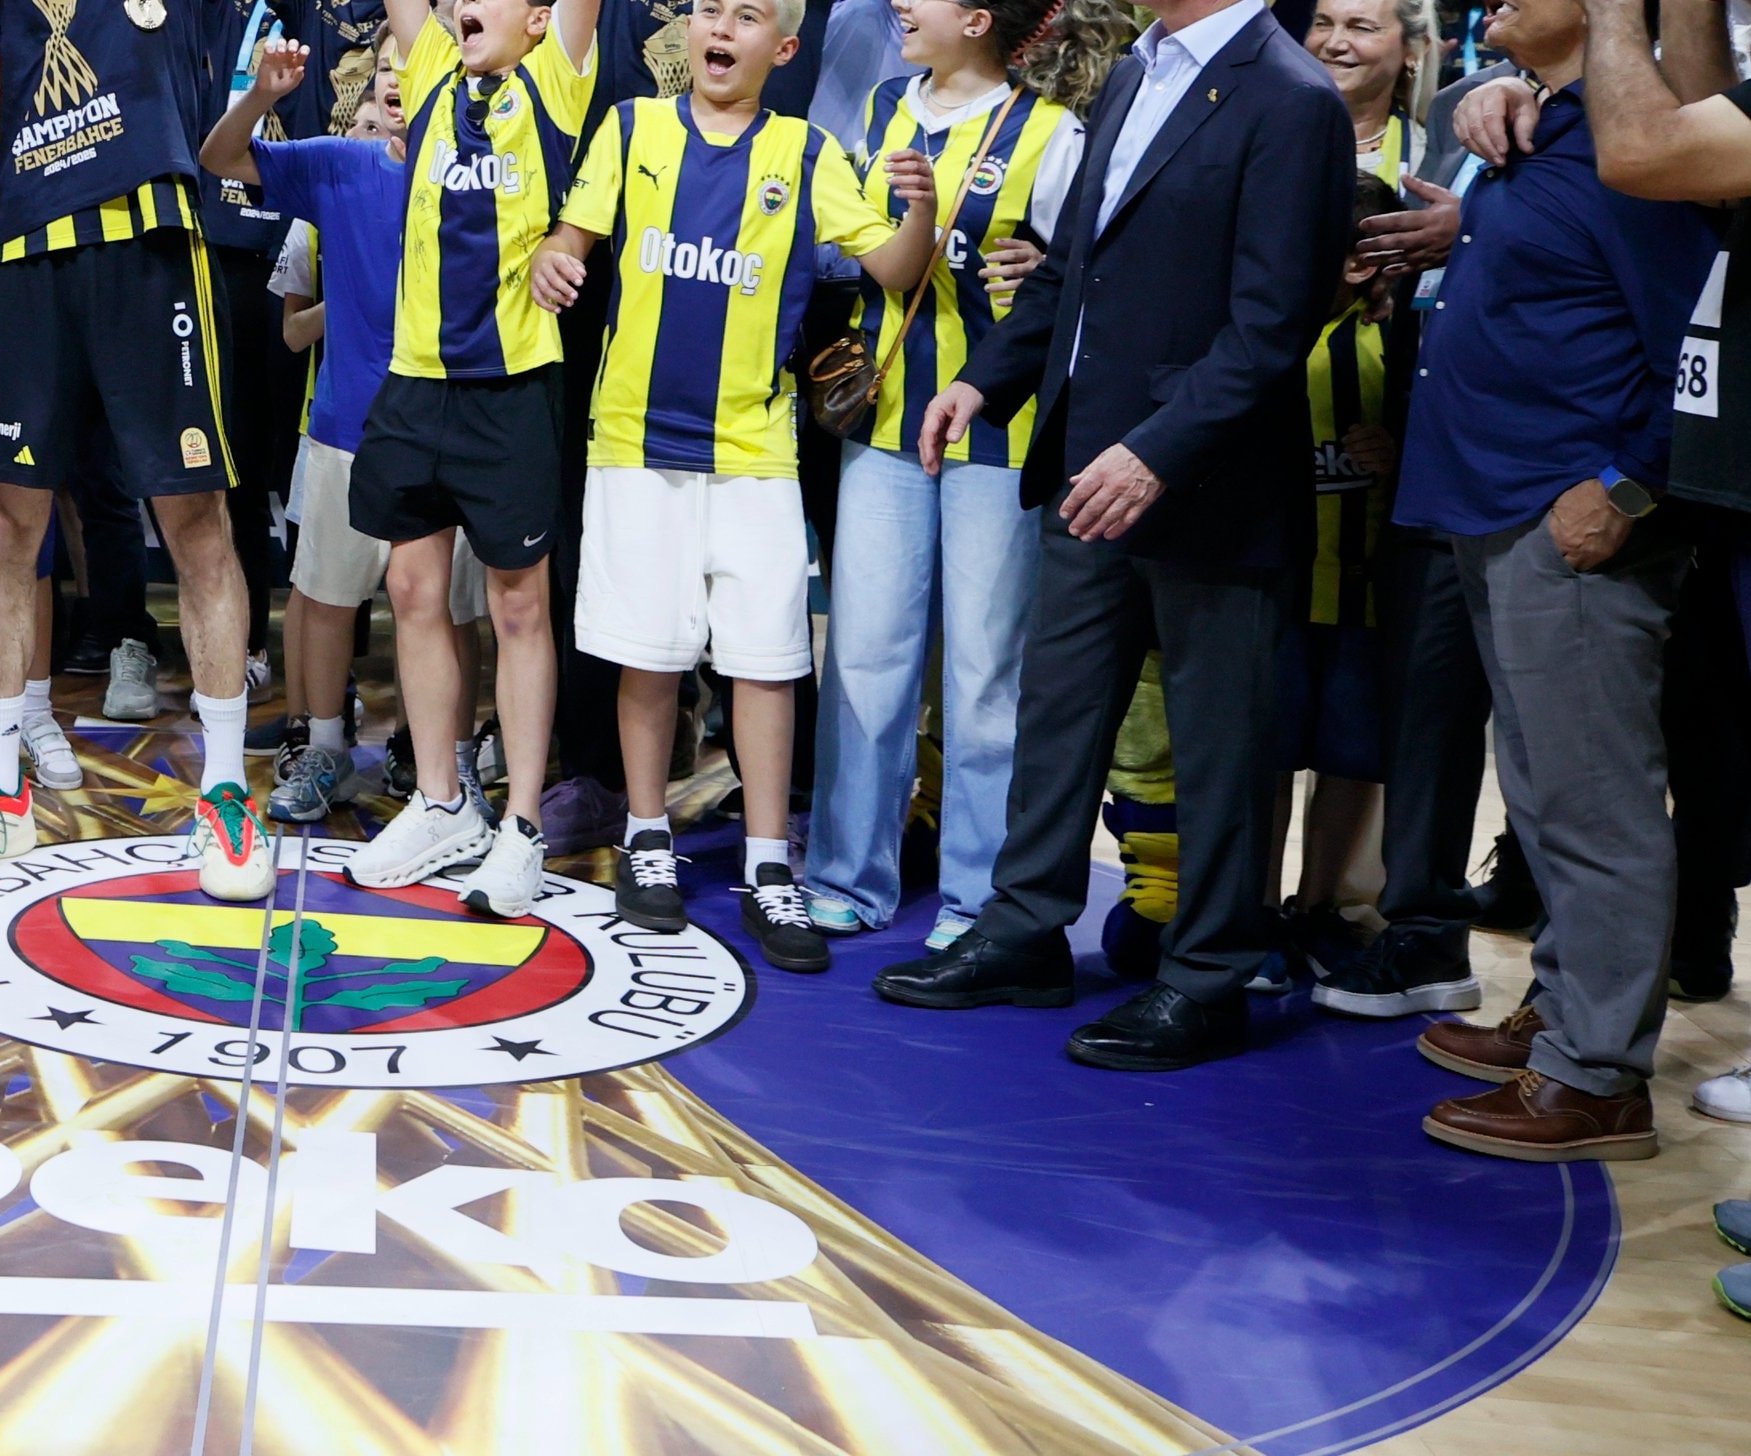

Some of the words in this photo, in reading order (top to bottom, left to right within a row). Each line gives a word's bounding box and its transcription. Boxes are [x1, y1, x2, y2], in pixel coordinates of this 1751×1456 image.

[12, 92, 120, 157] ŞAMPİYON
[14, 117, 125, 175] FENERBAHÇE
[429, 138, 521, 194] Otokoç
[639, 225, 764, 296] Otokoç
[181, 340, 193, 387] PETRONET
[150, 1028, 410, 1076] 1907
